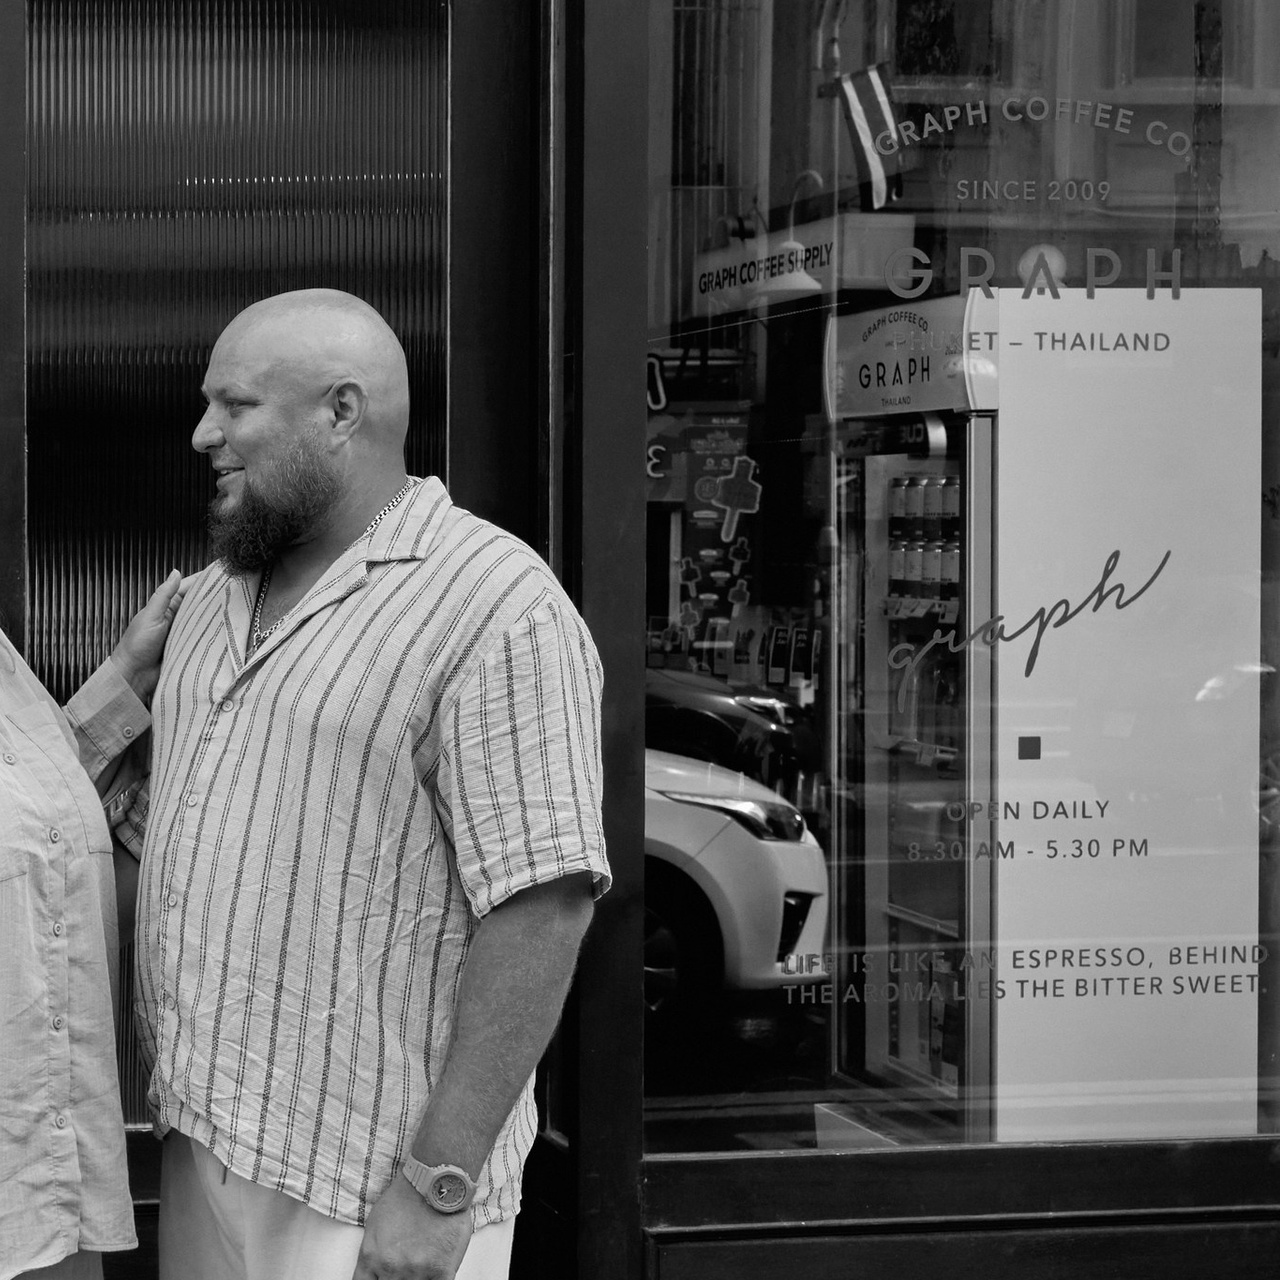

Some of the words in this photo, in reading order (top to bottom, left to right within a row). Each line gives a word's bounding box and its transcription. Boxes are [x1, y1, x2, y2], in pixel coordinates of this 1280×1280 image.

[874, 99, 988, 156] GRAPH
[1002, 96, 1134, 134] COFFEE
[956, 180, 1036, 201] SINCE
[1048, 180, 1111, 202] 2009
[699, 265, 737, 295] GRAPH
[739, 253, 785, 285] COFFEE
[788, 241, 833, 274] SUPPLY
[884, 246, 1182, 301] GRAPH
[888, 311, 917, 325] COFFEE
[1033, 331, 1171, 352] THAILAND
[859, 354, 930, 389] GRAPH
[881, 396, 912, 407] THAILAND
[888, 550, 1171, 713] graph
[947, 801, 1020, 822] OPEN
[1033, 800, 1110, 820] DAILY
[908, 841, 963, 862] 8.30
[975, 841, 1015, 860] AM
[1046, 838, 1101, 859] 5.30
[1112, 838, 1149, 858] PM
[782, 952, 835, 974] LIFE
[853, 952, 874, 973] IS
[890, 951, 945, 973] LIKE
[959, 950, 996, 970] AN
[1012, 947, 1153, 970] ESPRESSO,
[1170, 944, 1268, 966] BEHIND
[782, 983, 834, 1005] THE
[843, 982, 944, 1003] AROMA
[1016, 978, 1065, 999] THE
[1076, 976, 1163, 997] BITTER
[1172, 973, 1267, 995] SWEET.
